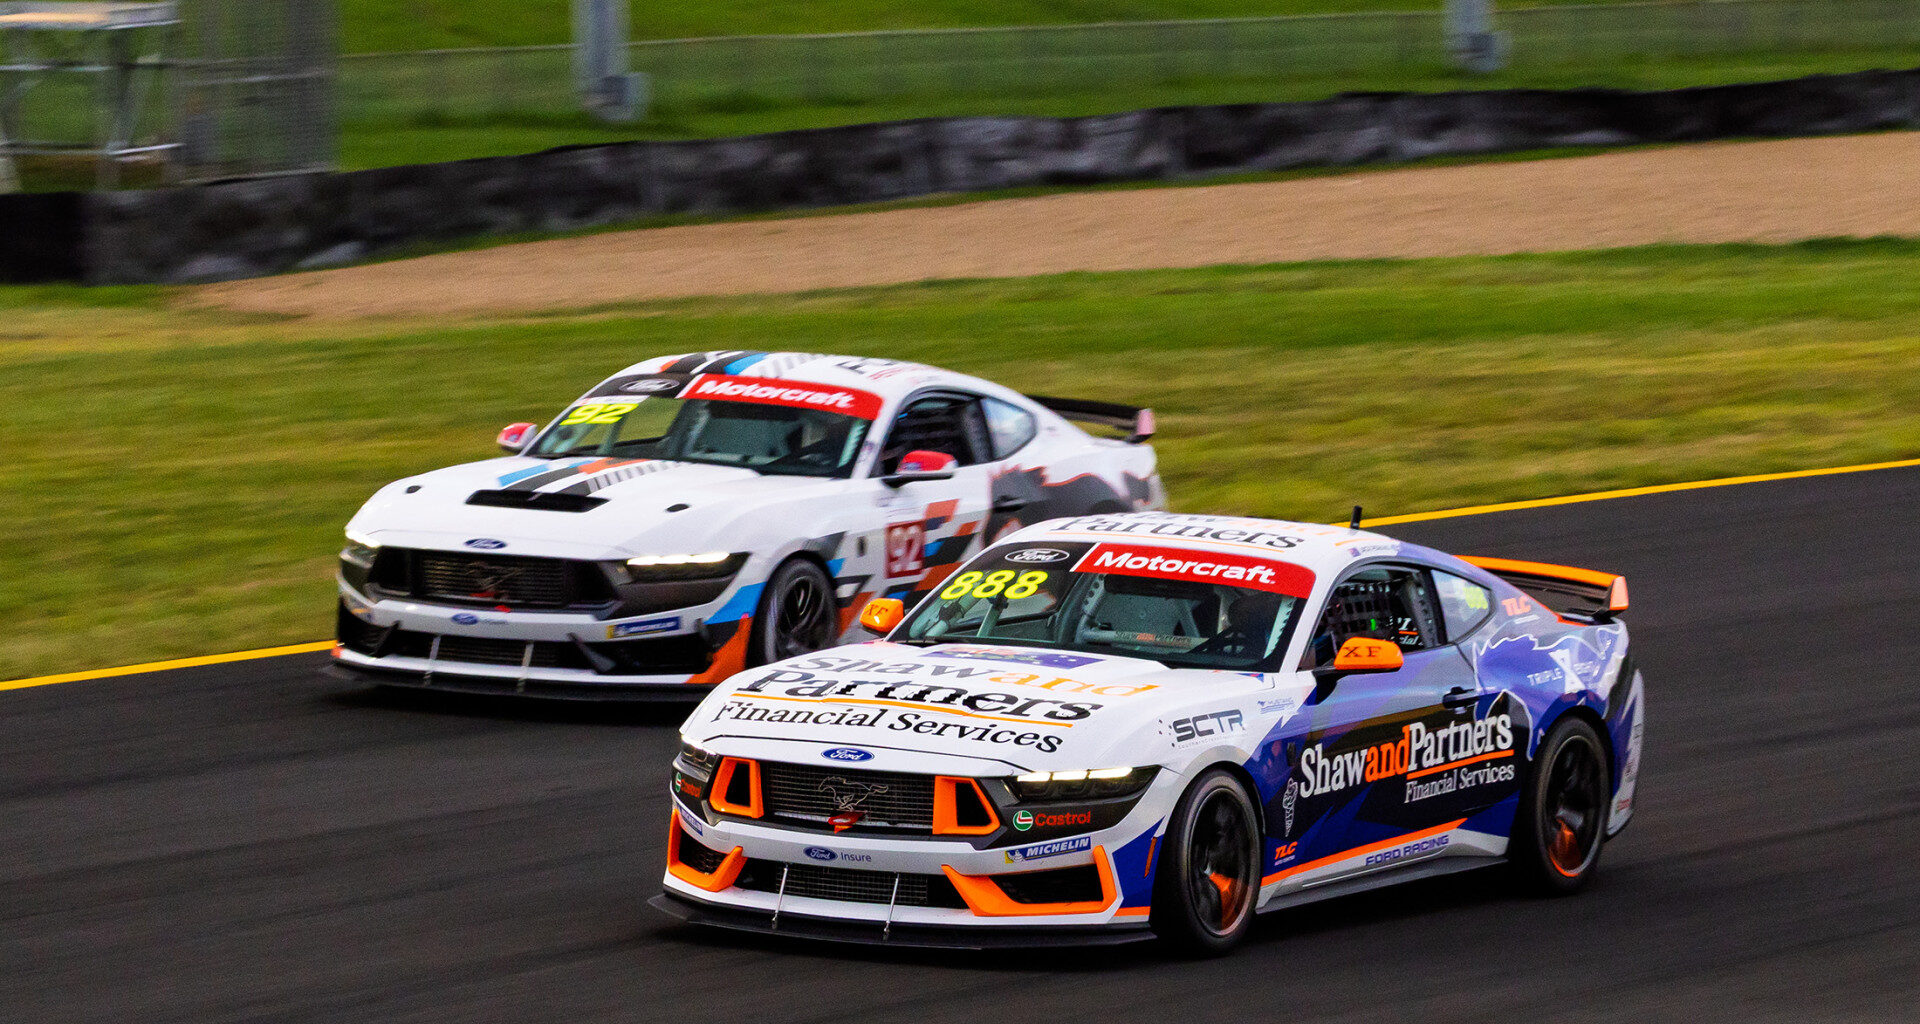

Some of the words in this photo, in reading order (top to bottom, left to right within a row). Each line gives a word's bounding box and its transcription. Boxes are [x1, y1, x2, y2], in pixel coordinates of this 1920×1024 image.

[699, 380, 854, 408] Motorcraft
[560, 403, 639, 425] 92
[1050, 517, 1304, 548] Partners
[891, 525, 921, 573] 92
[1012, 549, 1060, 562] Ford
[1094, 550, 1276, 584] Motorcraft
[941, 570, 1048, 599] 888
[1502, 596, 1531, 616] TLC
[737, 669, 1103, 721] Partners
[711, 701, 888, 727] Financial
[888, 712, 1064, 753] Services
[1172, 709, 1245, 742] SCTR
[829, 748, 865, 762] Ford
[1404, 768, 1457, 803] Financial
[1458, 763, 1515, 791] Services
[1035, 811, 1091, 827] Castrol
[808, 847, 834, 861] Ford
[841, 851, 872, 863] Insure
[1026, 837, 1089, 857] MICHELIN
[1275, 841, 1298, 860] TLC
[1365, 848, 1400, 867] FORD
[1402, 835, 1449, 857] RACING
